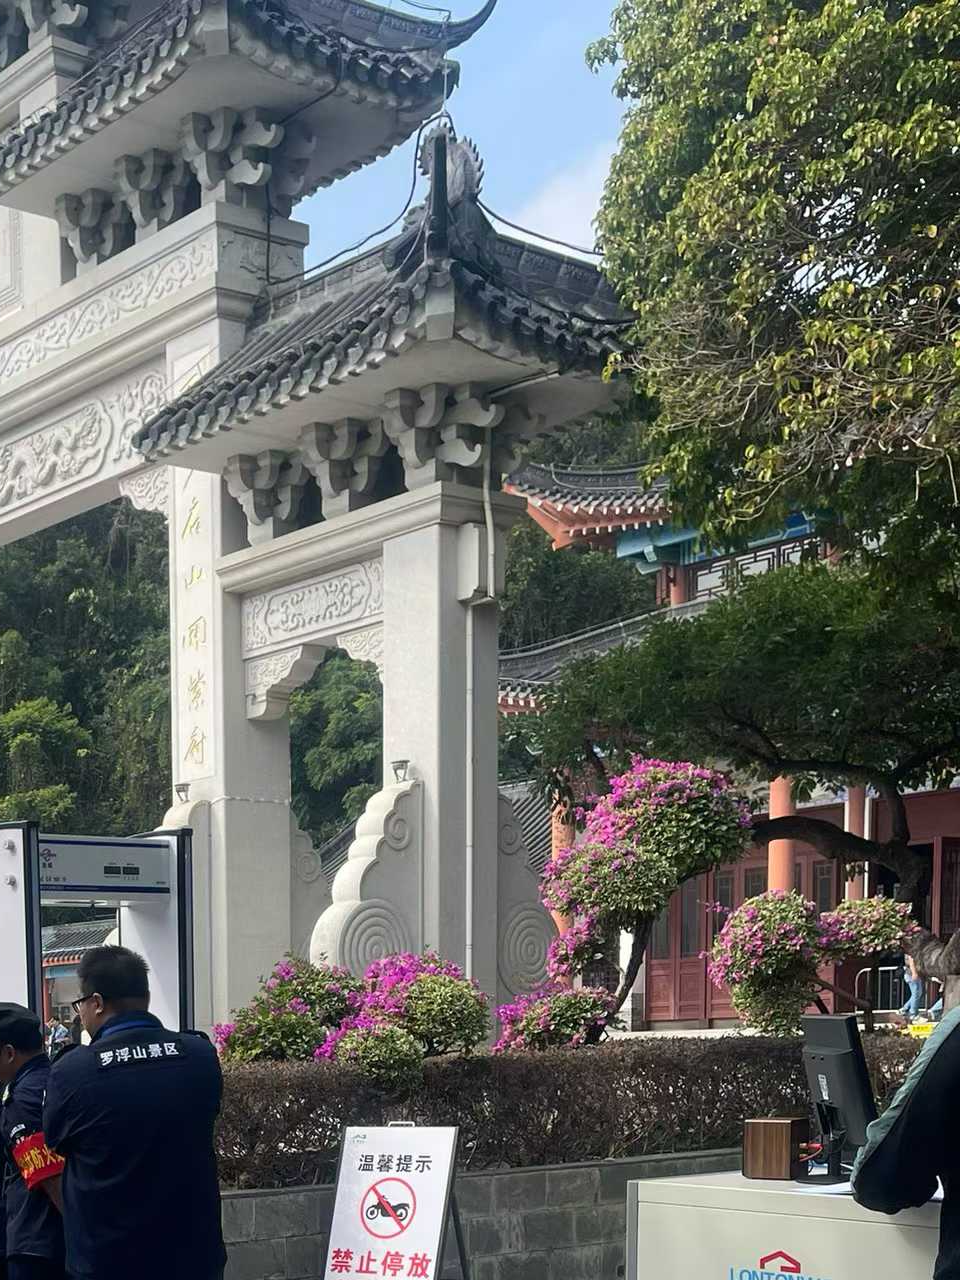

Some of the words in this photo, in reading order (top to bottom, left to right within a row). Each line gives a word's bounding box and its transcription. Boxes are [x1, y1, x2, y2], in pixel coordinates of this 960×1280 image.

[100, 1042, 179, 1066] 罗浮山景区
[358, 1154, 432, 1173] 温馨提示
[330, 1248, 431, 1278] 禁止停放
